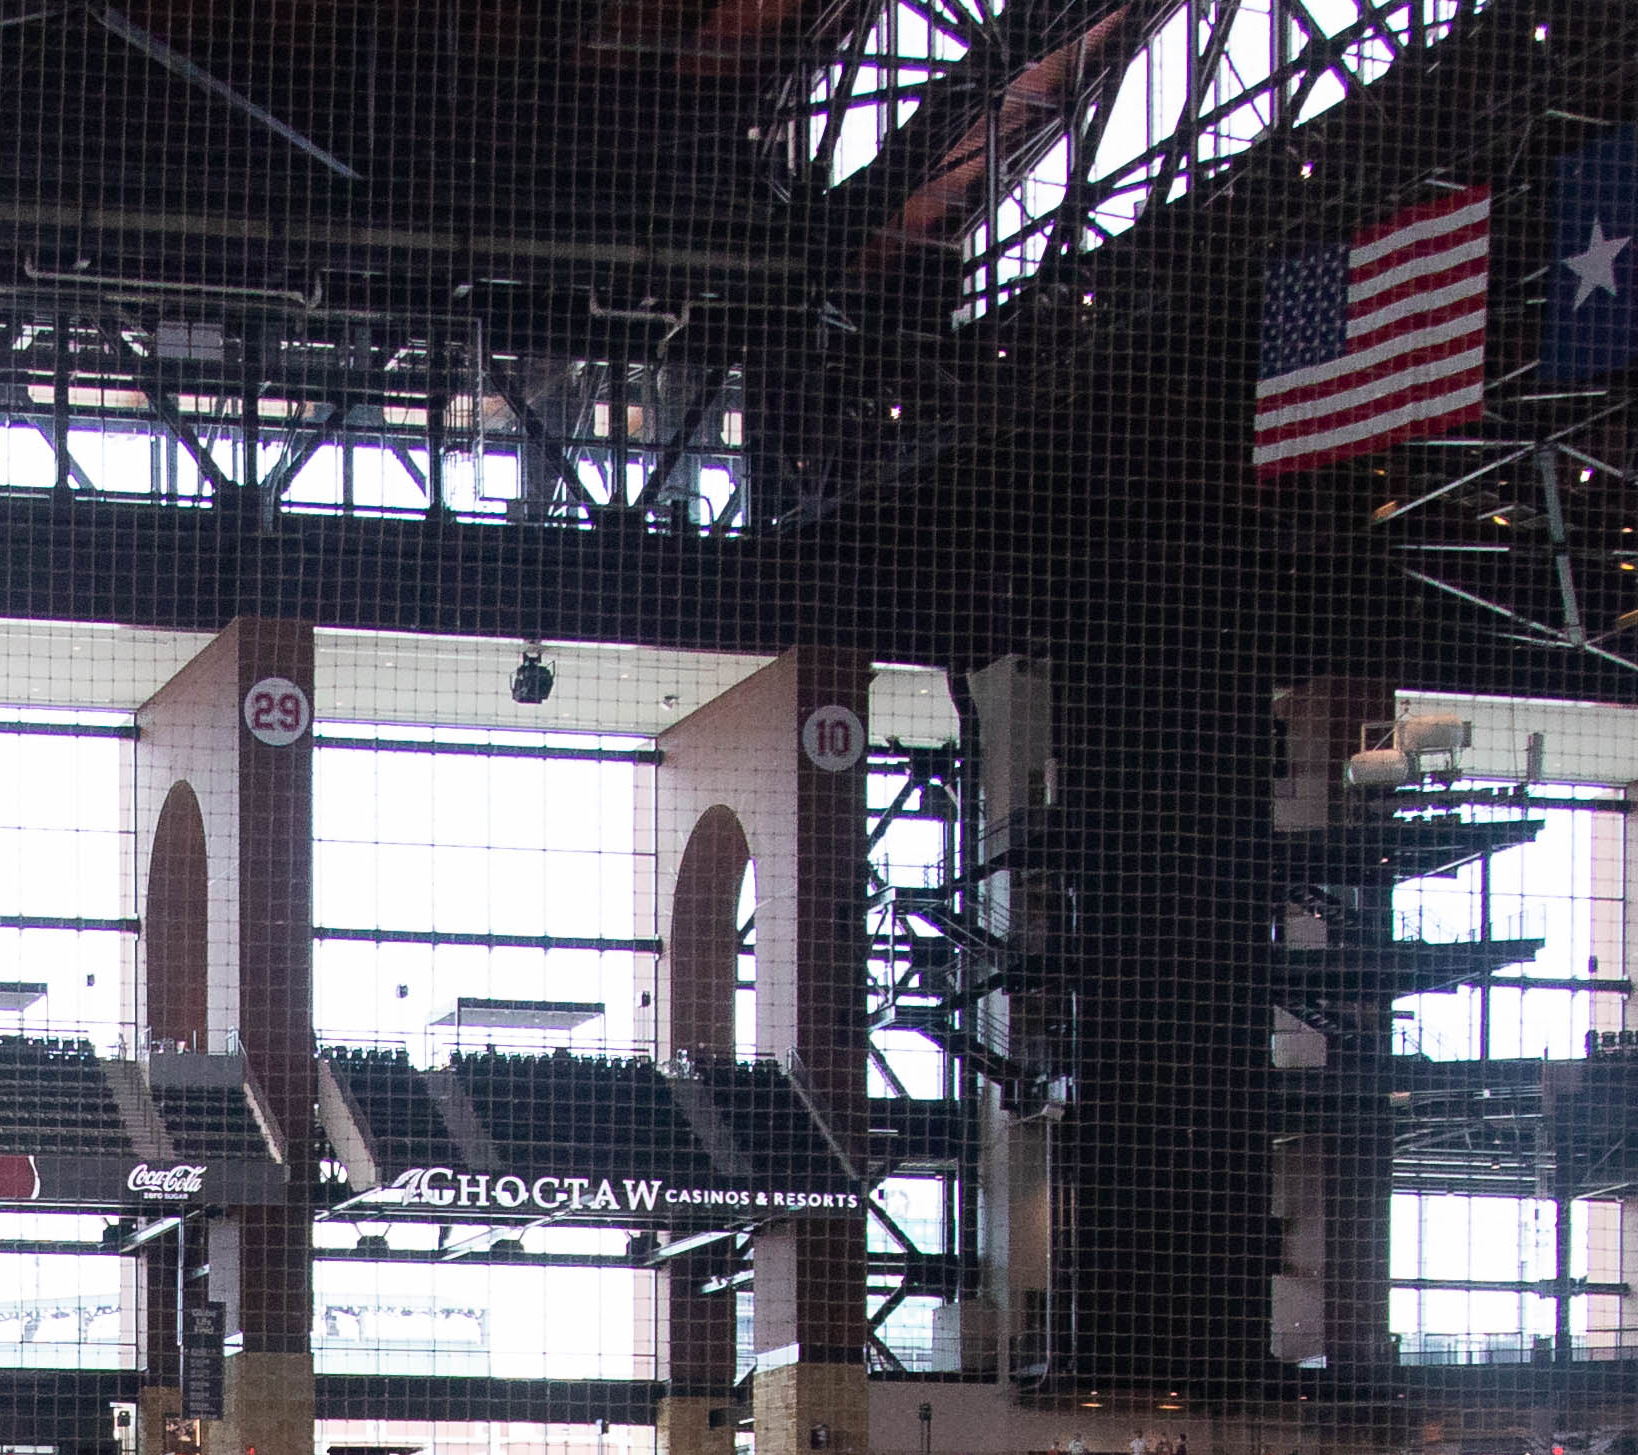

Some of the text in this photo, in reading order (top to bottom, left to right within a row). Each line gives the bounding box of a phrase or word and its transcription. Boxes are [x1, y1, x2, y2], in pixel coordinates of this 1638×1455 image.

[252, 691, 301, 731] 29
[814, 718, 851, 758] 10
[127, 1163, 208, 1192] Coca-Cola
[419, 1167, 858, 1211] CHOCTAW CASINOS & RESORTS
